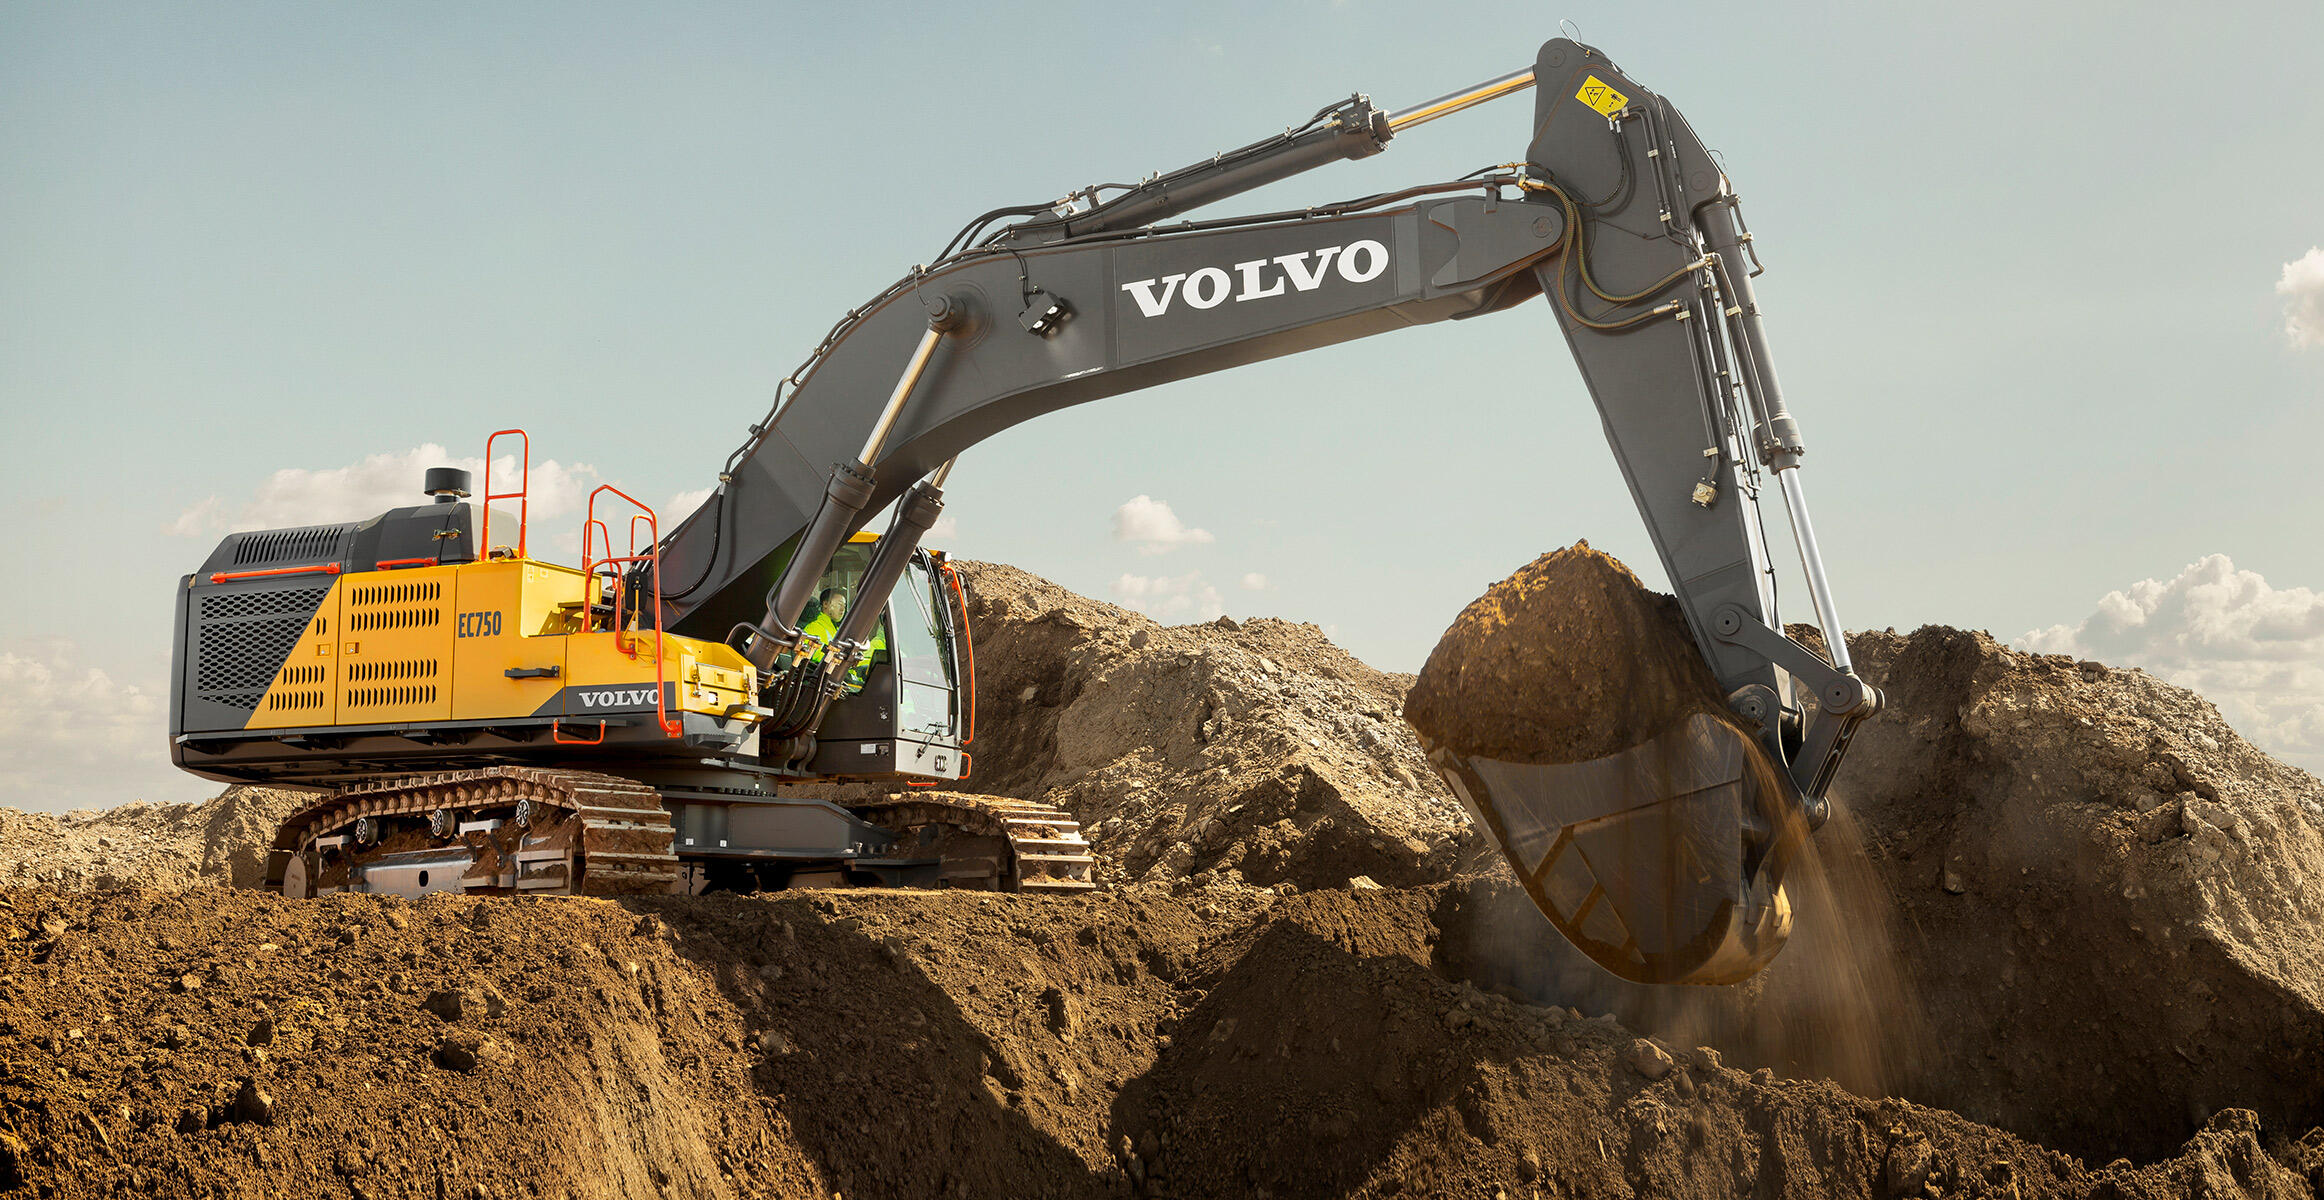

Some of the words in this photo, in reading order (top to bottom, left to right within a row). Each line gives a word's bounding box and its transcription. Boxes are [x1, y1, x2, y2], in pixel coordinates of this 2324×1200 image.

[1122, 240, 1389, 318] VOLVO
[458, 611, 502, 638] EC750
[579, 689, 659, 707] VOLVO
